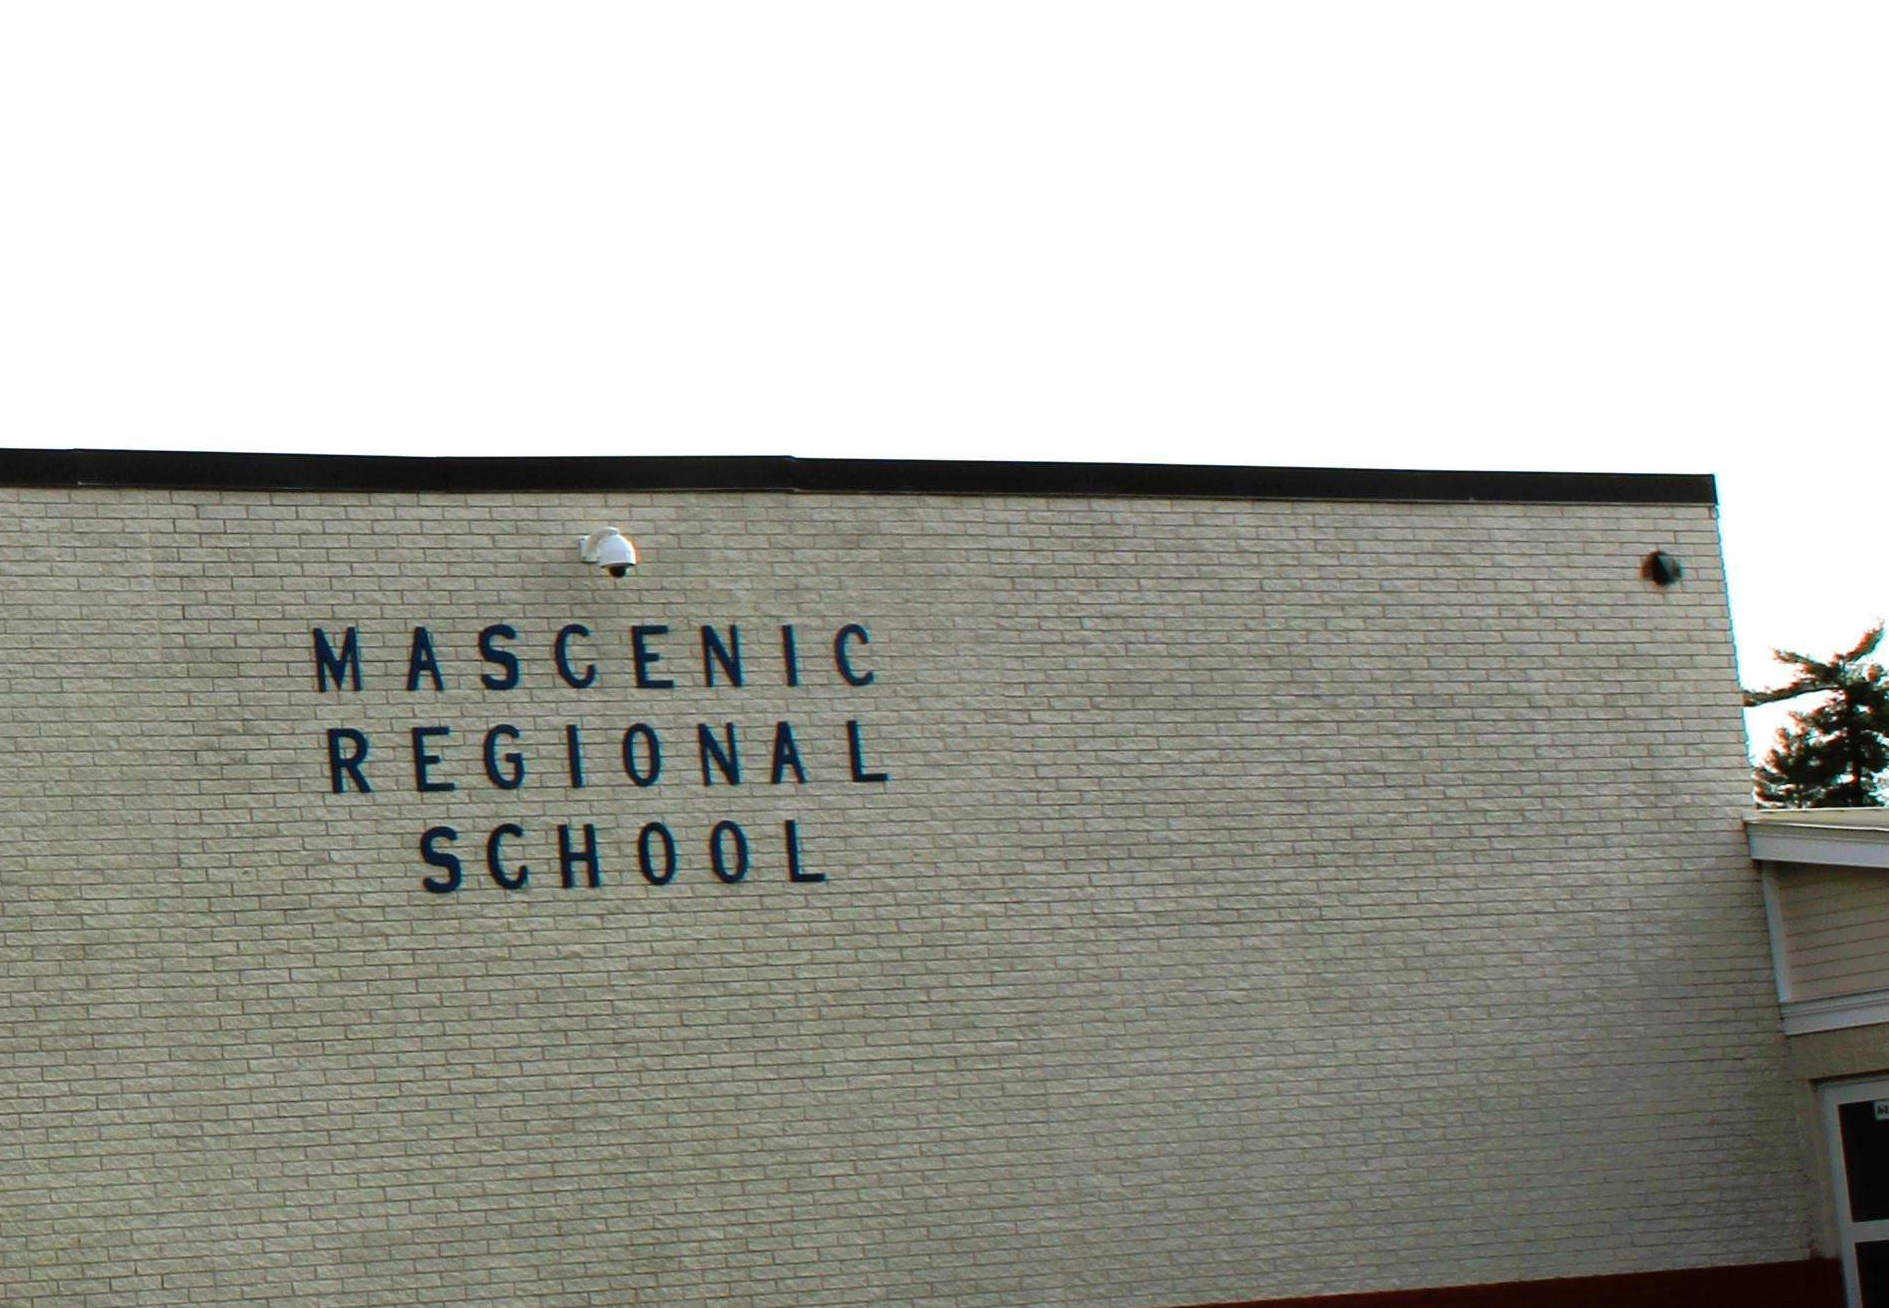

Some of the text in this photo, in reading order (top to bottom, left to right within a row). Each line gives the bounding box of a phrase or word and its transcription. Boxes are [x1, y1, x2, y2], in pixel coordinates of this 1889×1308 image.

[312, 624, 876, 693] MASCENIC
[327, 720, 890, 794] REGIONAL
[419, 820, 828, 894] SCHOOL
